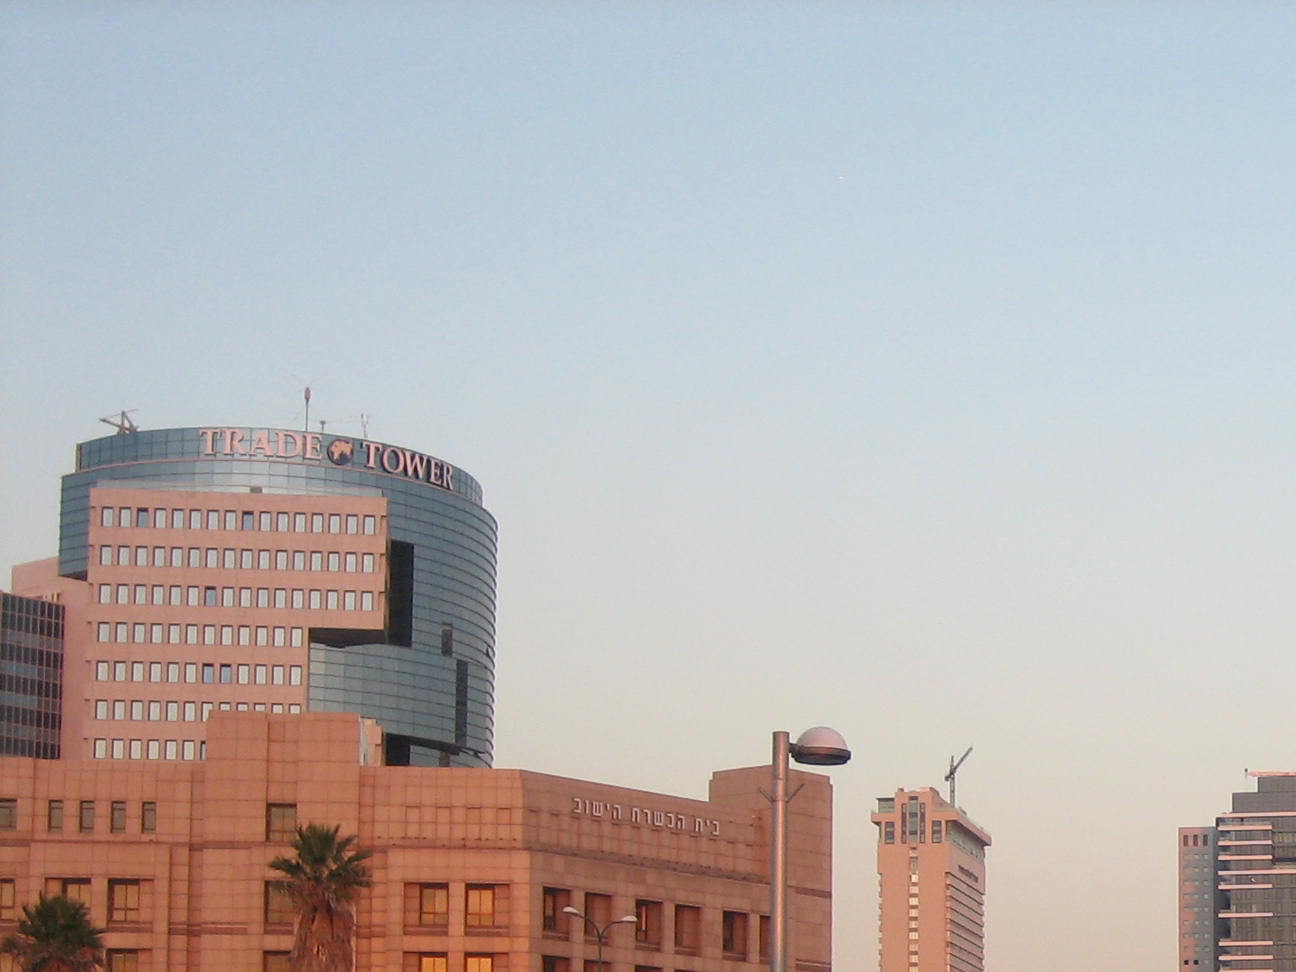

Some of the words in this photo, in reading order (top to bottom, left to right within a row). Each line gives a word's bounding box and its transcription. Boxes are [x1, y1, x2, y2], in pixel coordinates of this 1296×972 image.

[200, 428, 323, 461] TRADE
[361, 440, 454, 491] TOWER
[573, 797, 621, 820] הישוב
[631, 807, 685, 830] הכשרת
[695, 817, 720, 836] בית
